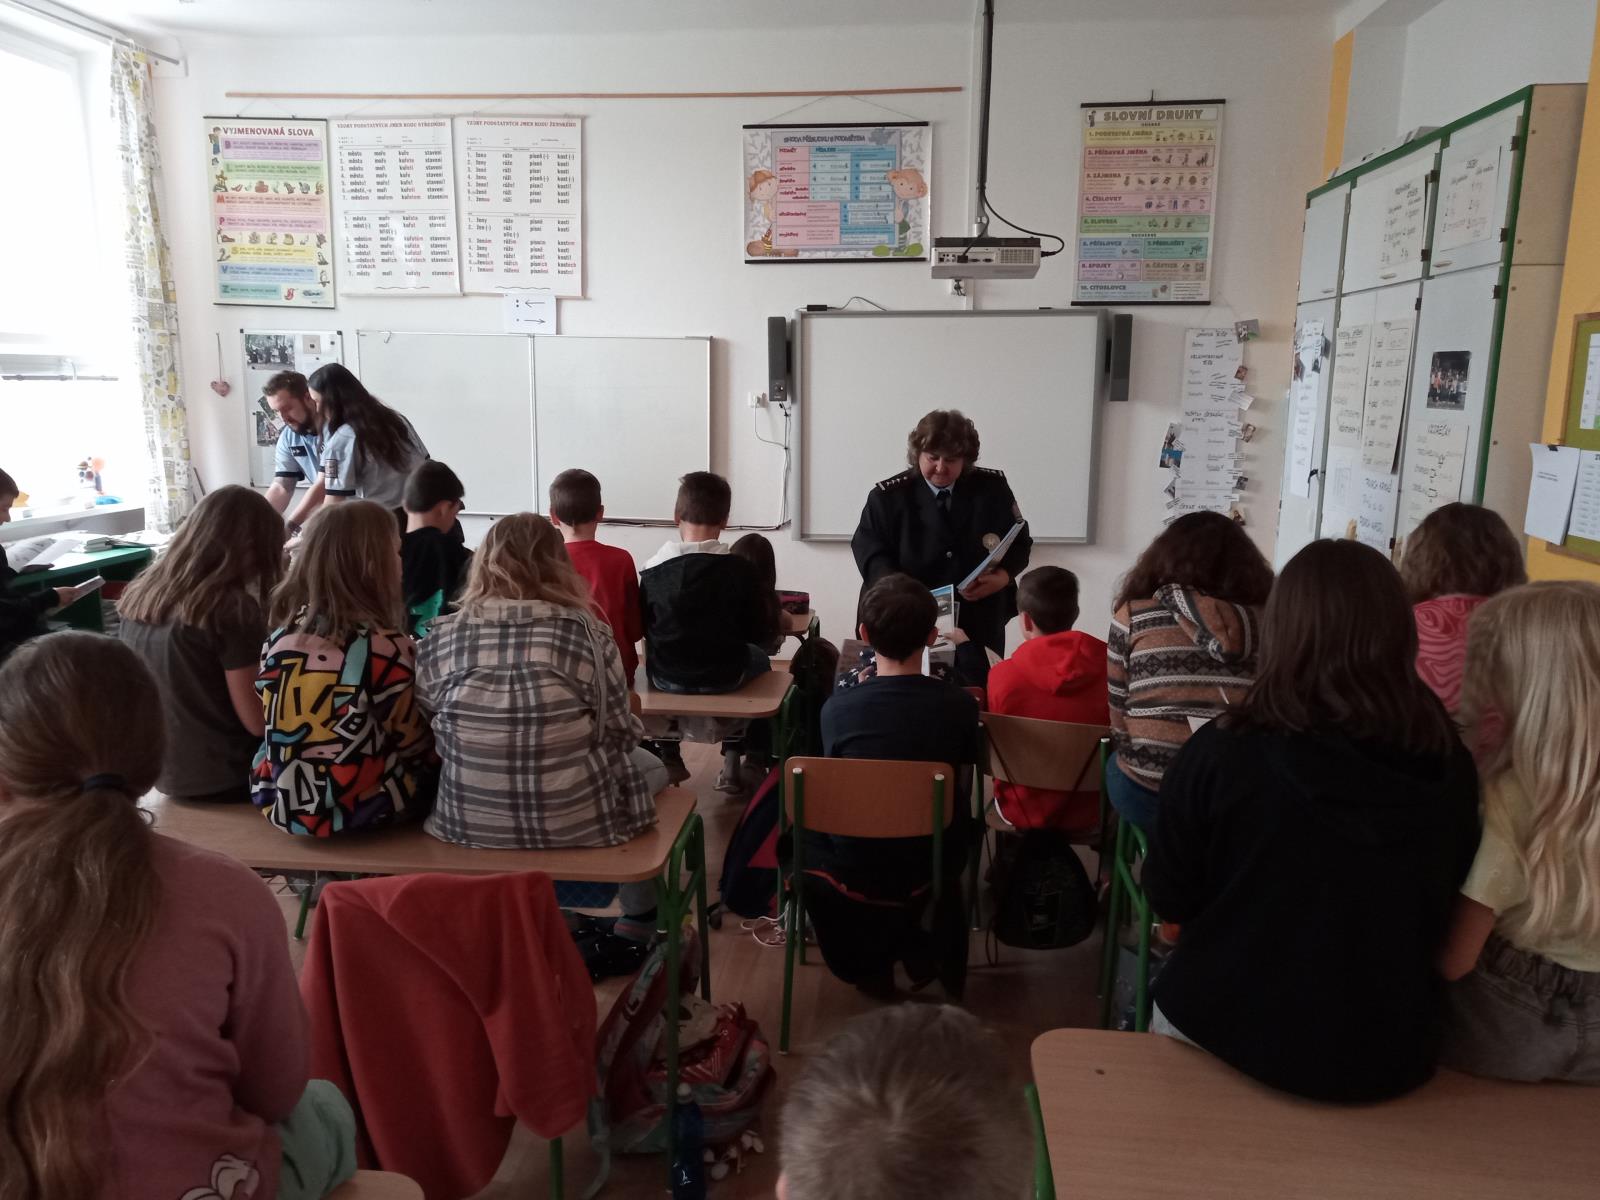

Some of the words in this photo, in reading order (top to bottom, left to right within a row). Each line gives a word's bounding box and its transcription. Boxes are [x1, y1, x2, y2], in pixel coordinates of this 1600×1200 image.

[1104, 108, 1153, 121] SLOVNÍ
[1156, 109, 1203, 120] DRUHY
[223, 127, 285, 135] VYJMENOVANÁ
[288, 128, 314, 136] SLOVA
